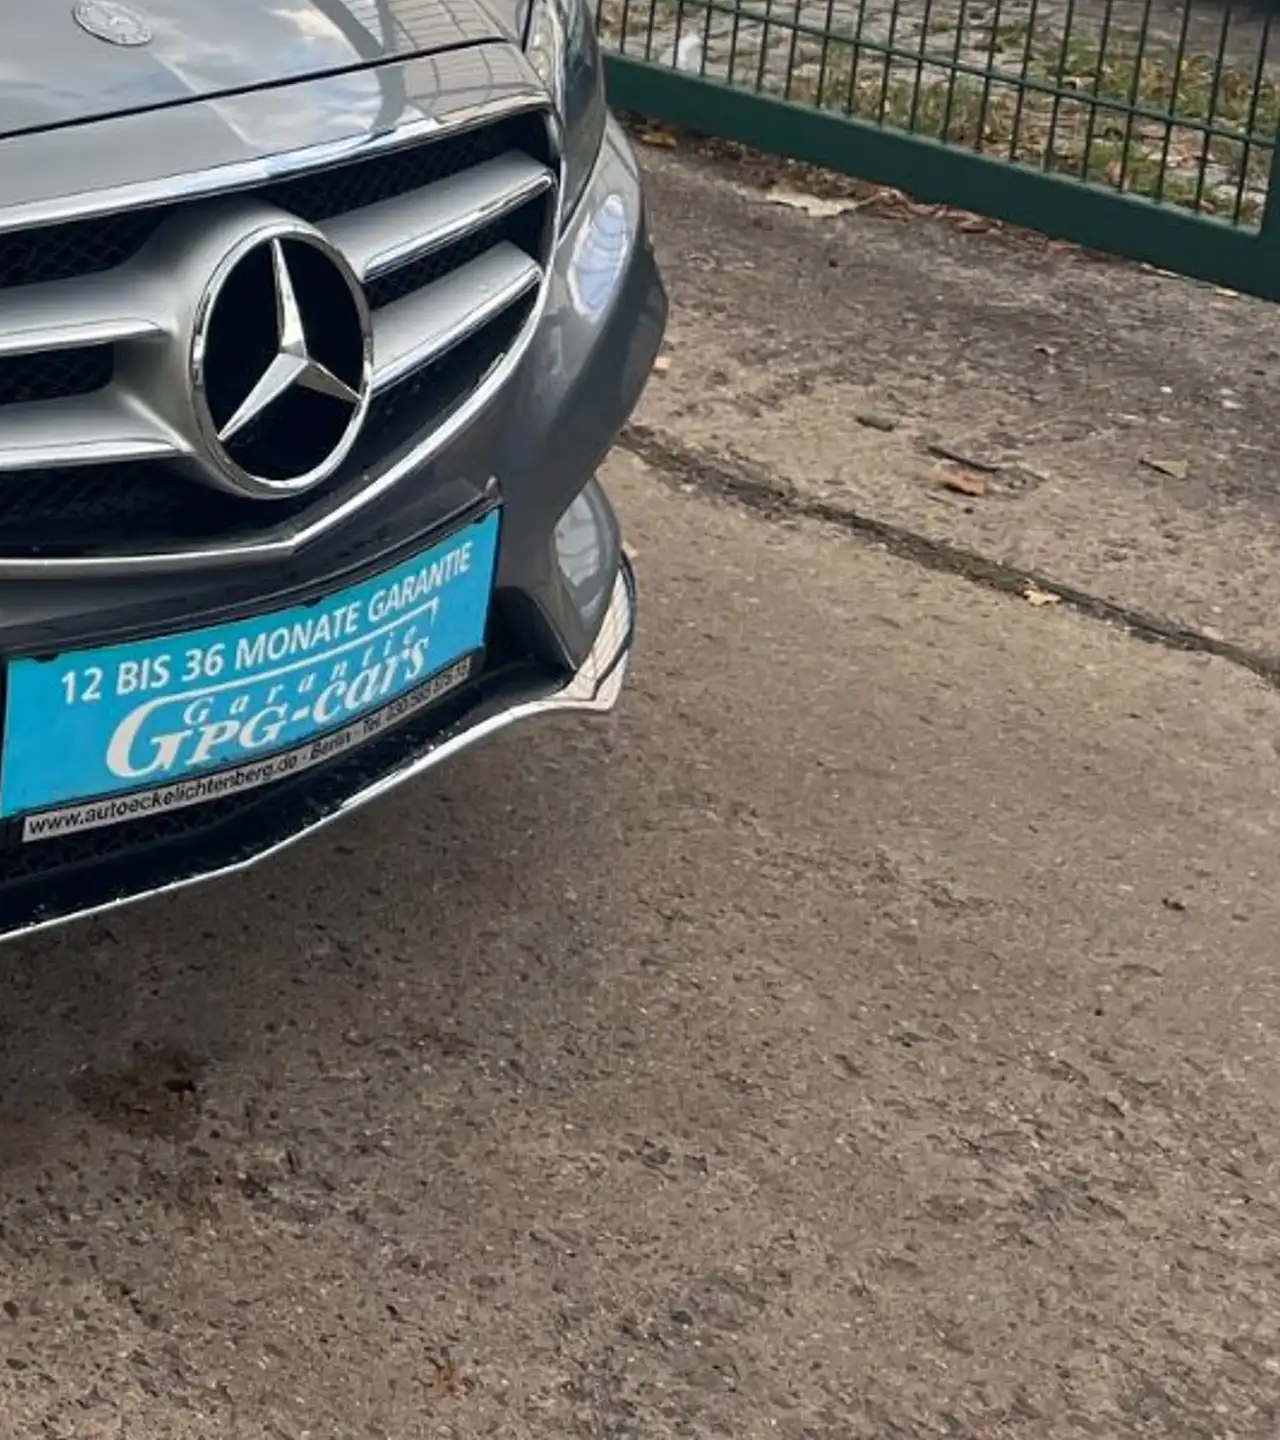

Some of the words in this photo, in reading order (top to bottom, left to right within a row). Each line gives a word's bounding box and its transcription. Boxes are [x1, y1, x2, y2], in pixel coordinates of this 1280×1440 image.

[61, 667, 102, 704] 12
[117, 654, 170, 695] BIS
[181, 643, 225, 682] 36
[234, 601, 360, 670] MONATE
[368, 541, 473, 624] GARANTIE
